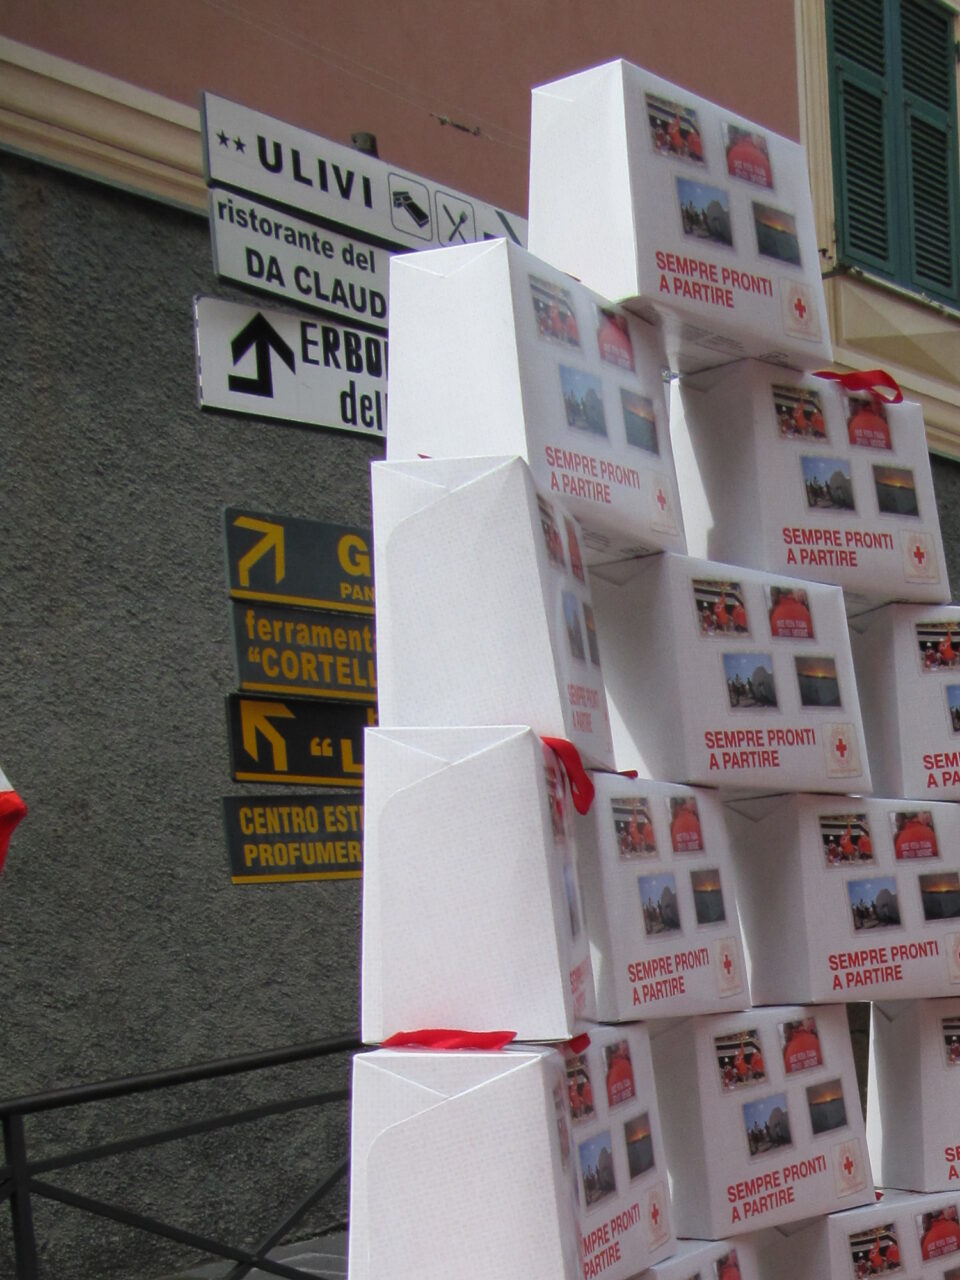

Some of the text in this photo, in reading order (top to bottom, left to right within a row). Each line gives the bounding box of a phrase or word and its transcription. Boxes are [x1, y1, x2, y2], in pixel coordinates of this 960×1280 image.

[257, 135, 373, 209] ULIVI
[217, 198, 376, 273] ristorante del
[245, 247, 387, 319] DA CLAUD
[655, 249, 773, 295] SEMPRE PRONTI
[659, 273, 733, 308] A PARTIRE
[300, 320, 388, 380] ERBO
[340, 380, 388, 431] del
[543, 444, 641, 486] SEMPRE PRONTI
[549, 470, 611, 506] A PARTIRE
[782, 526, 894, 552] SEMPRE PRONTI
[787, 546, 857, 568] A PARTIRE
[246, 609, 376, 653] ferrament
[704, 726, 816, 751] SEMPRE PRONTI
[709, 748, 779, 770] A PARTIRE
[927, 772, 939, 788] A
[239, 806, 319, 835] CENTRO
[244, 842, 363, 866] PROFUMER
[627, 947, 709, 984] SEMPRE PRONTI
[828, 939, 939, 974] SEMPRE PRONTI
[632, 974, 685, 1005] A PARTIRE
[832, 963, 902, 990] A PARTIRE
[727, 1154, 827, 1204] SEMPRE PRONTI
[948, 1162, 960, 1180] A
[731, 1186, 794, 1223] A PARTIRE
